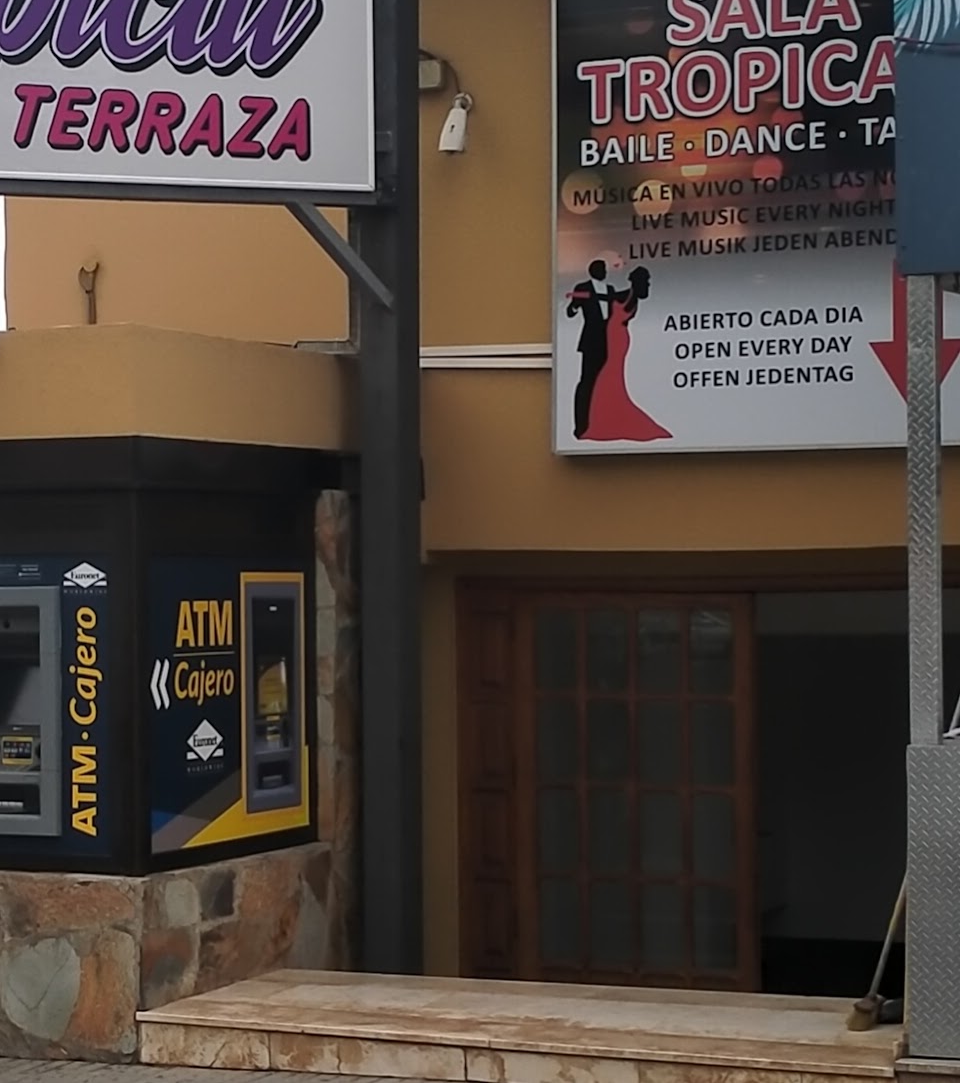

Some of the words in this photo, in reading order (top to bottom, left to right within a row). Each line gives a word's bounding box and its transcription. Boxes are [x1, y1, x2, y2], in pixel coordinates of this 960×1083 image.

[14, 84, 311, 160] TERRAZA
[580, 132, 674, 167] BAILE
[706, 120, 826, 157] DANCE
[573, 185, 653, 206] MÚSICA
[660, 182, 686, 201] EN
[693, 177, 744, 197] VIVO
[751, 172, 821, 193] TODAS
[829, 170, 865, 190] LAS
[632, 212, 674, 230] LIVE
[681, 208, 749, 227] MUSIC
[756, 204, 821, 223] EVERY
[829, 199, 896, 218] NIGHT
[629, 241, 671, 259] LIVE
[678, 236, 746, 256] MUSIK
[752, 232, 817, 253] JEDEN
[824, 228, 896, 249] ABEND
[664, 311, 753, 332] ABIERTO
[760, 309, 818, 327] CADA
[826, 306, 863, 324] DIA
[675, 341, 731, 360] OPEN
[739, 338, 804, 357] EVERY
[811, 336, 852, 354] DAY
[673, 370, 740, 388] OFFEN
[746, 365, 854, 386] JEDENTAG
[175, 599, 234, 648] ATM
[174, 660, 234, 706] Cajero
